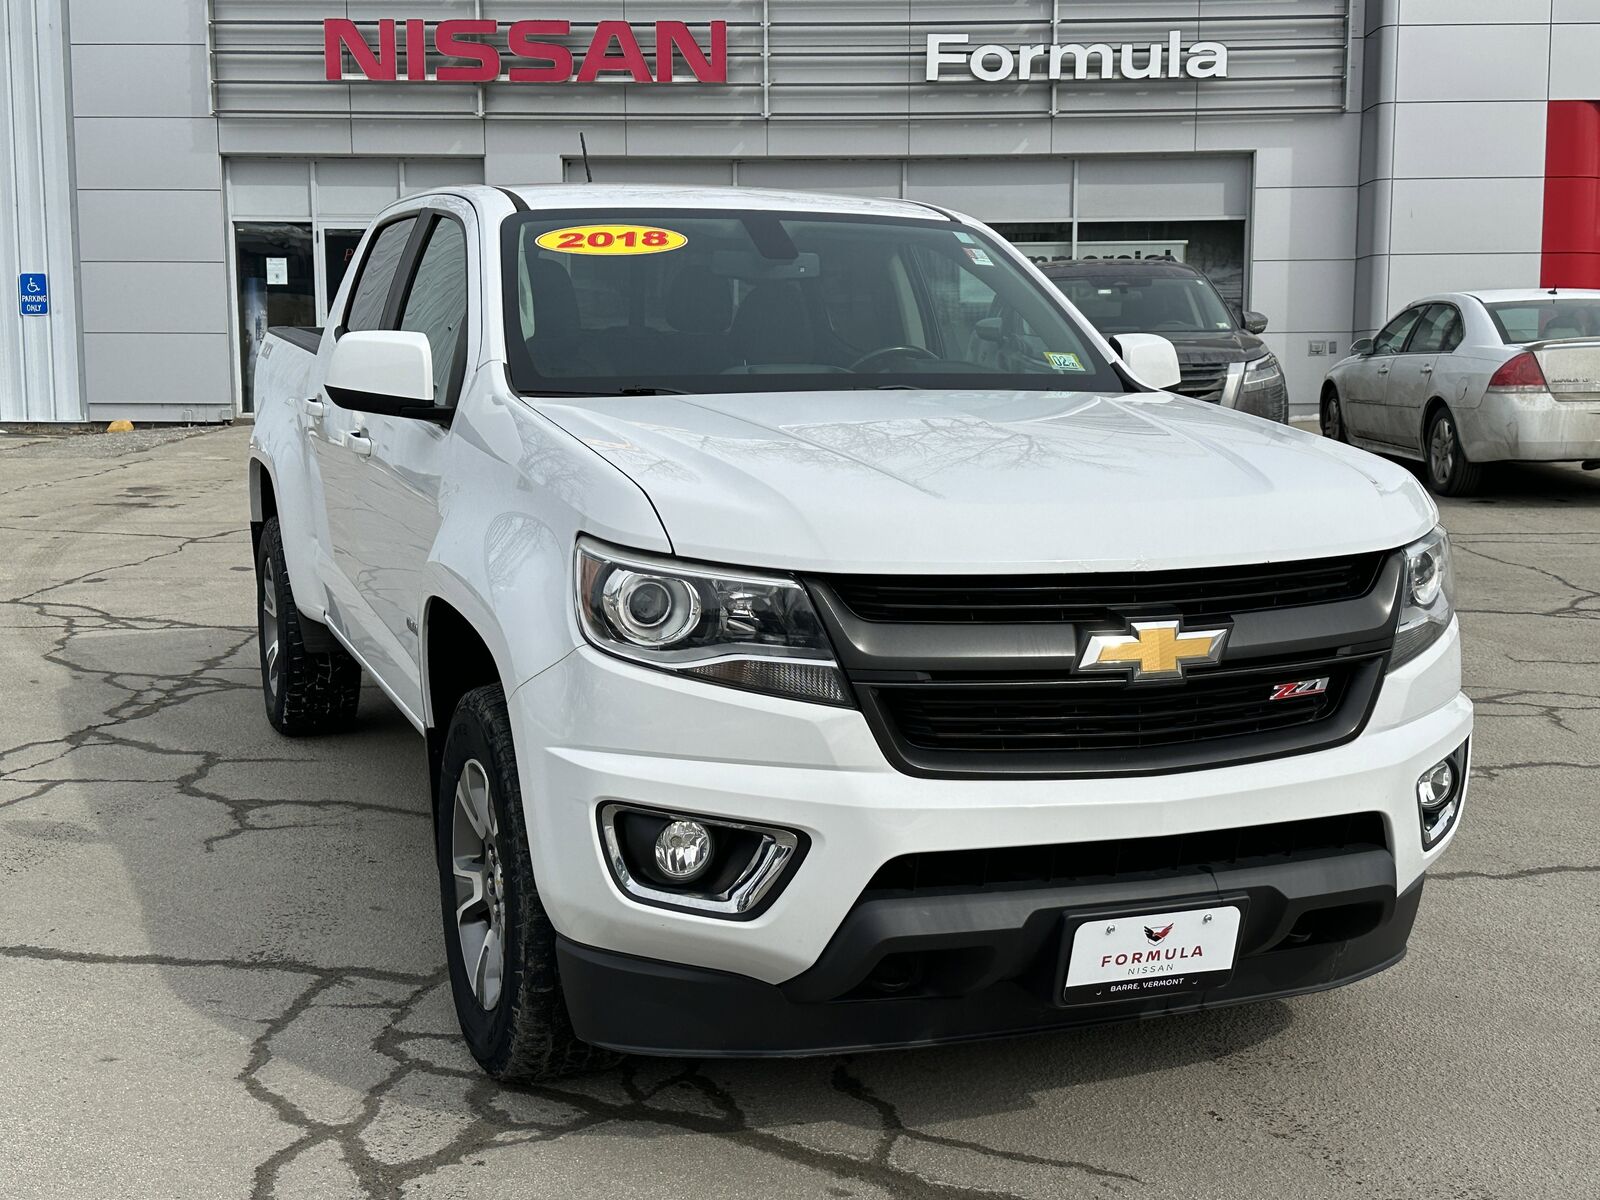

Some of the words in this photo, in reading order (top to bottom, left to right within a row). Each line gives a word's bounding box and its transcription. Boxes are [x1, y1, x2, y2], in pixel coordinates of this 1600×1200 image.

[324, 18, 727, 83] NISSAN
[926, 30, 1228, 82] Formula
[556, 231, 669, 249] 2018
[26, 304, 42, 312] ONLY
[1269, 677, 1330, 700] Z71
[1101, 945, 1203, 968] FORMULA
[1127, 963, 1174, 975] NISSAN
[1110, 982, 1140, 992] BARRE,
[1142, 977, 1184, 989] VERMONT
